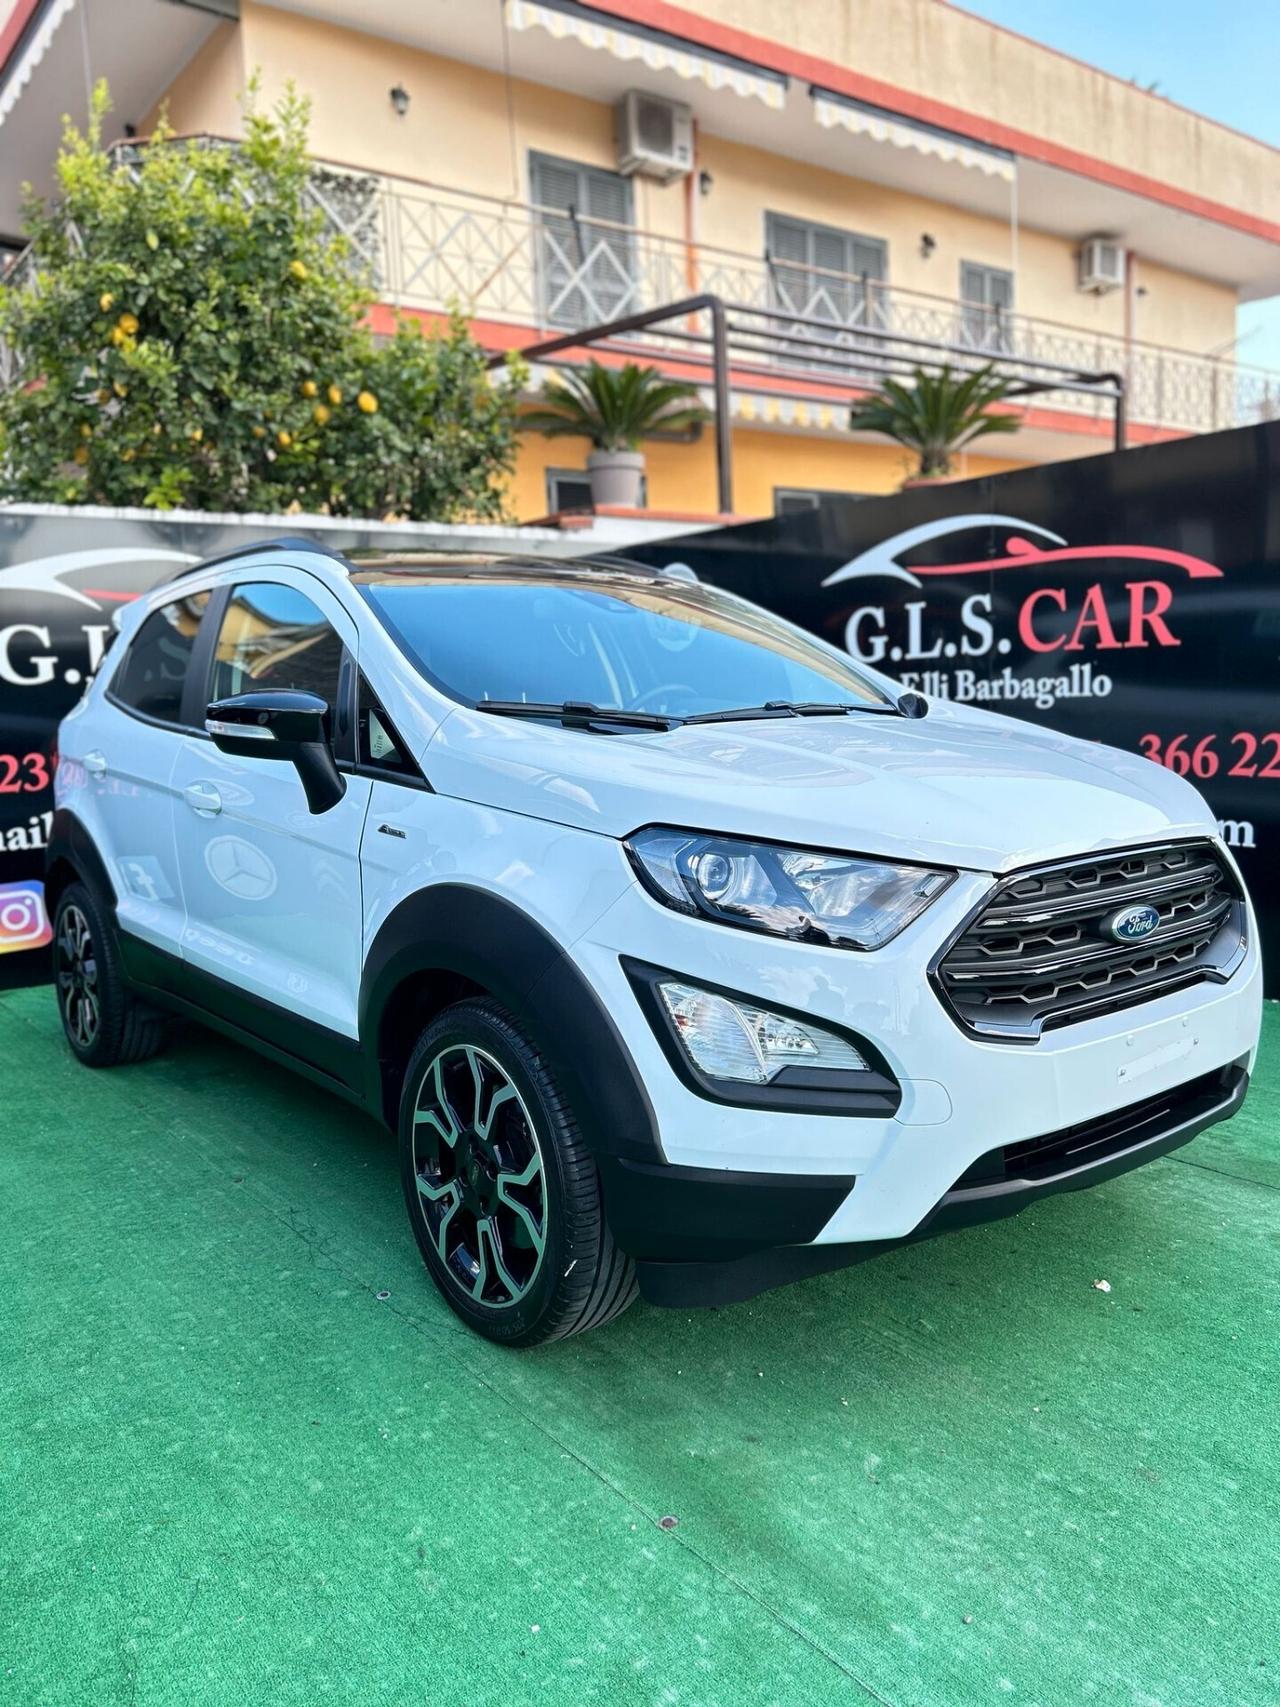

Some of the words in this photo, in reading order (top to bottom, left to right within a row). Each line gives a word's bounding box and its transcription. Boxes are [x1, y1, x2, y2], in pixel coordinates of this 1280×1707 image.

[845, 593, 1012, 664] G.L.S.
[1018, 580, 1182, 653] CAR
[954, 662, 1113, 710] Barbagallo
[1139, 734, 1219, 778] 366
[1128, 912, 1154, 934] Ford
